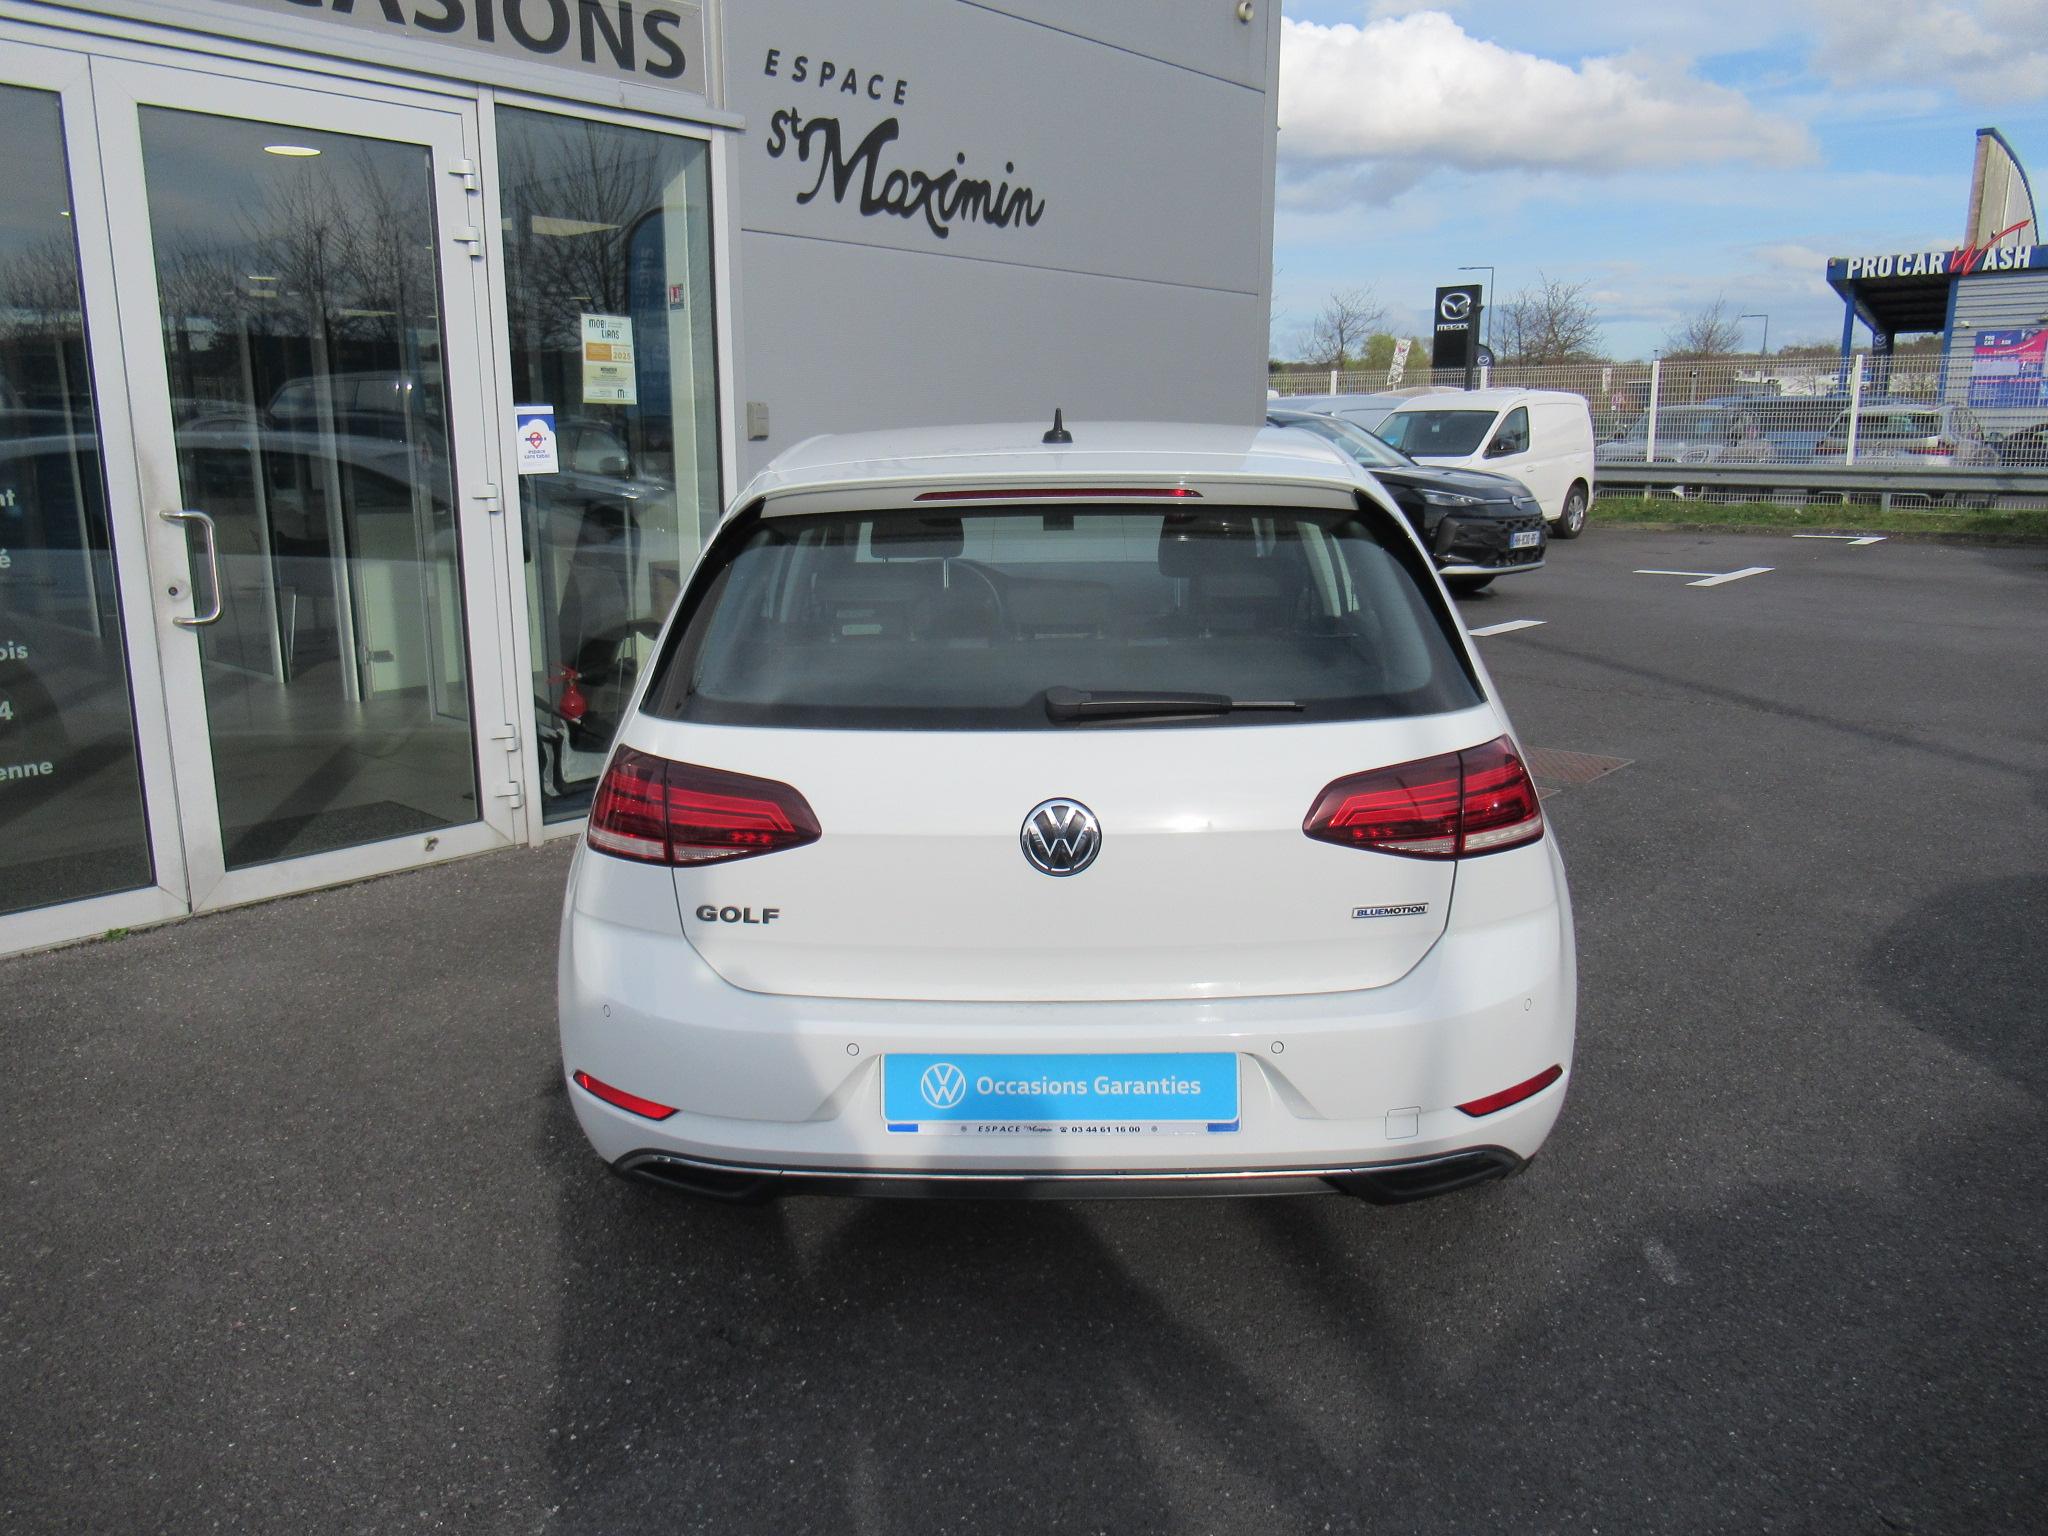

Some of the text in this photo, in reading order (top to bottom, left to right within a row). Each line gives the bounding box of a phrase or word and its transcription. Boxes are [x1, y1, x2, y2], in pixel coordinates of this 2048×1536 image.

[764, 48, 907, 105] ESPACE
[796, 117, 1045, 239] Maximin
[1846, 255, 1893, 280] PRO
[1896, 252, 1945, 277] CAR
[695, 904, 780, 924] GOLF
[1355, 905, 1427, 917] BLUEMOTION
[976, 1076, 1201, 1096] Occasions Garanties
[977, 1124, 1021, 1132] ESPACE
